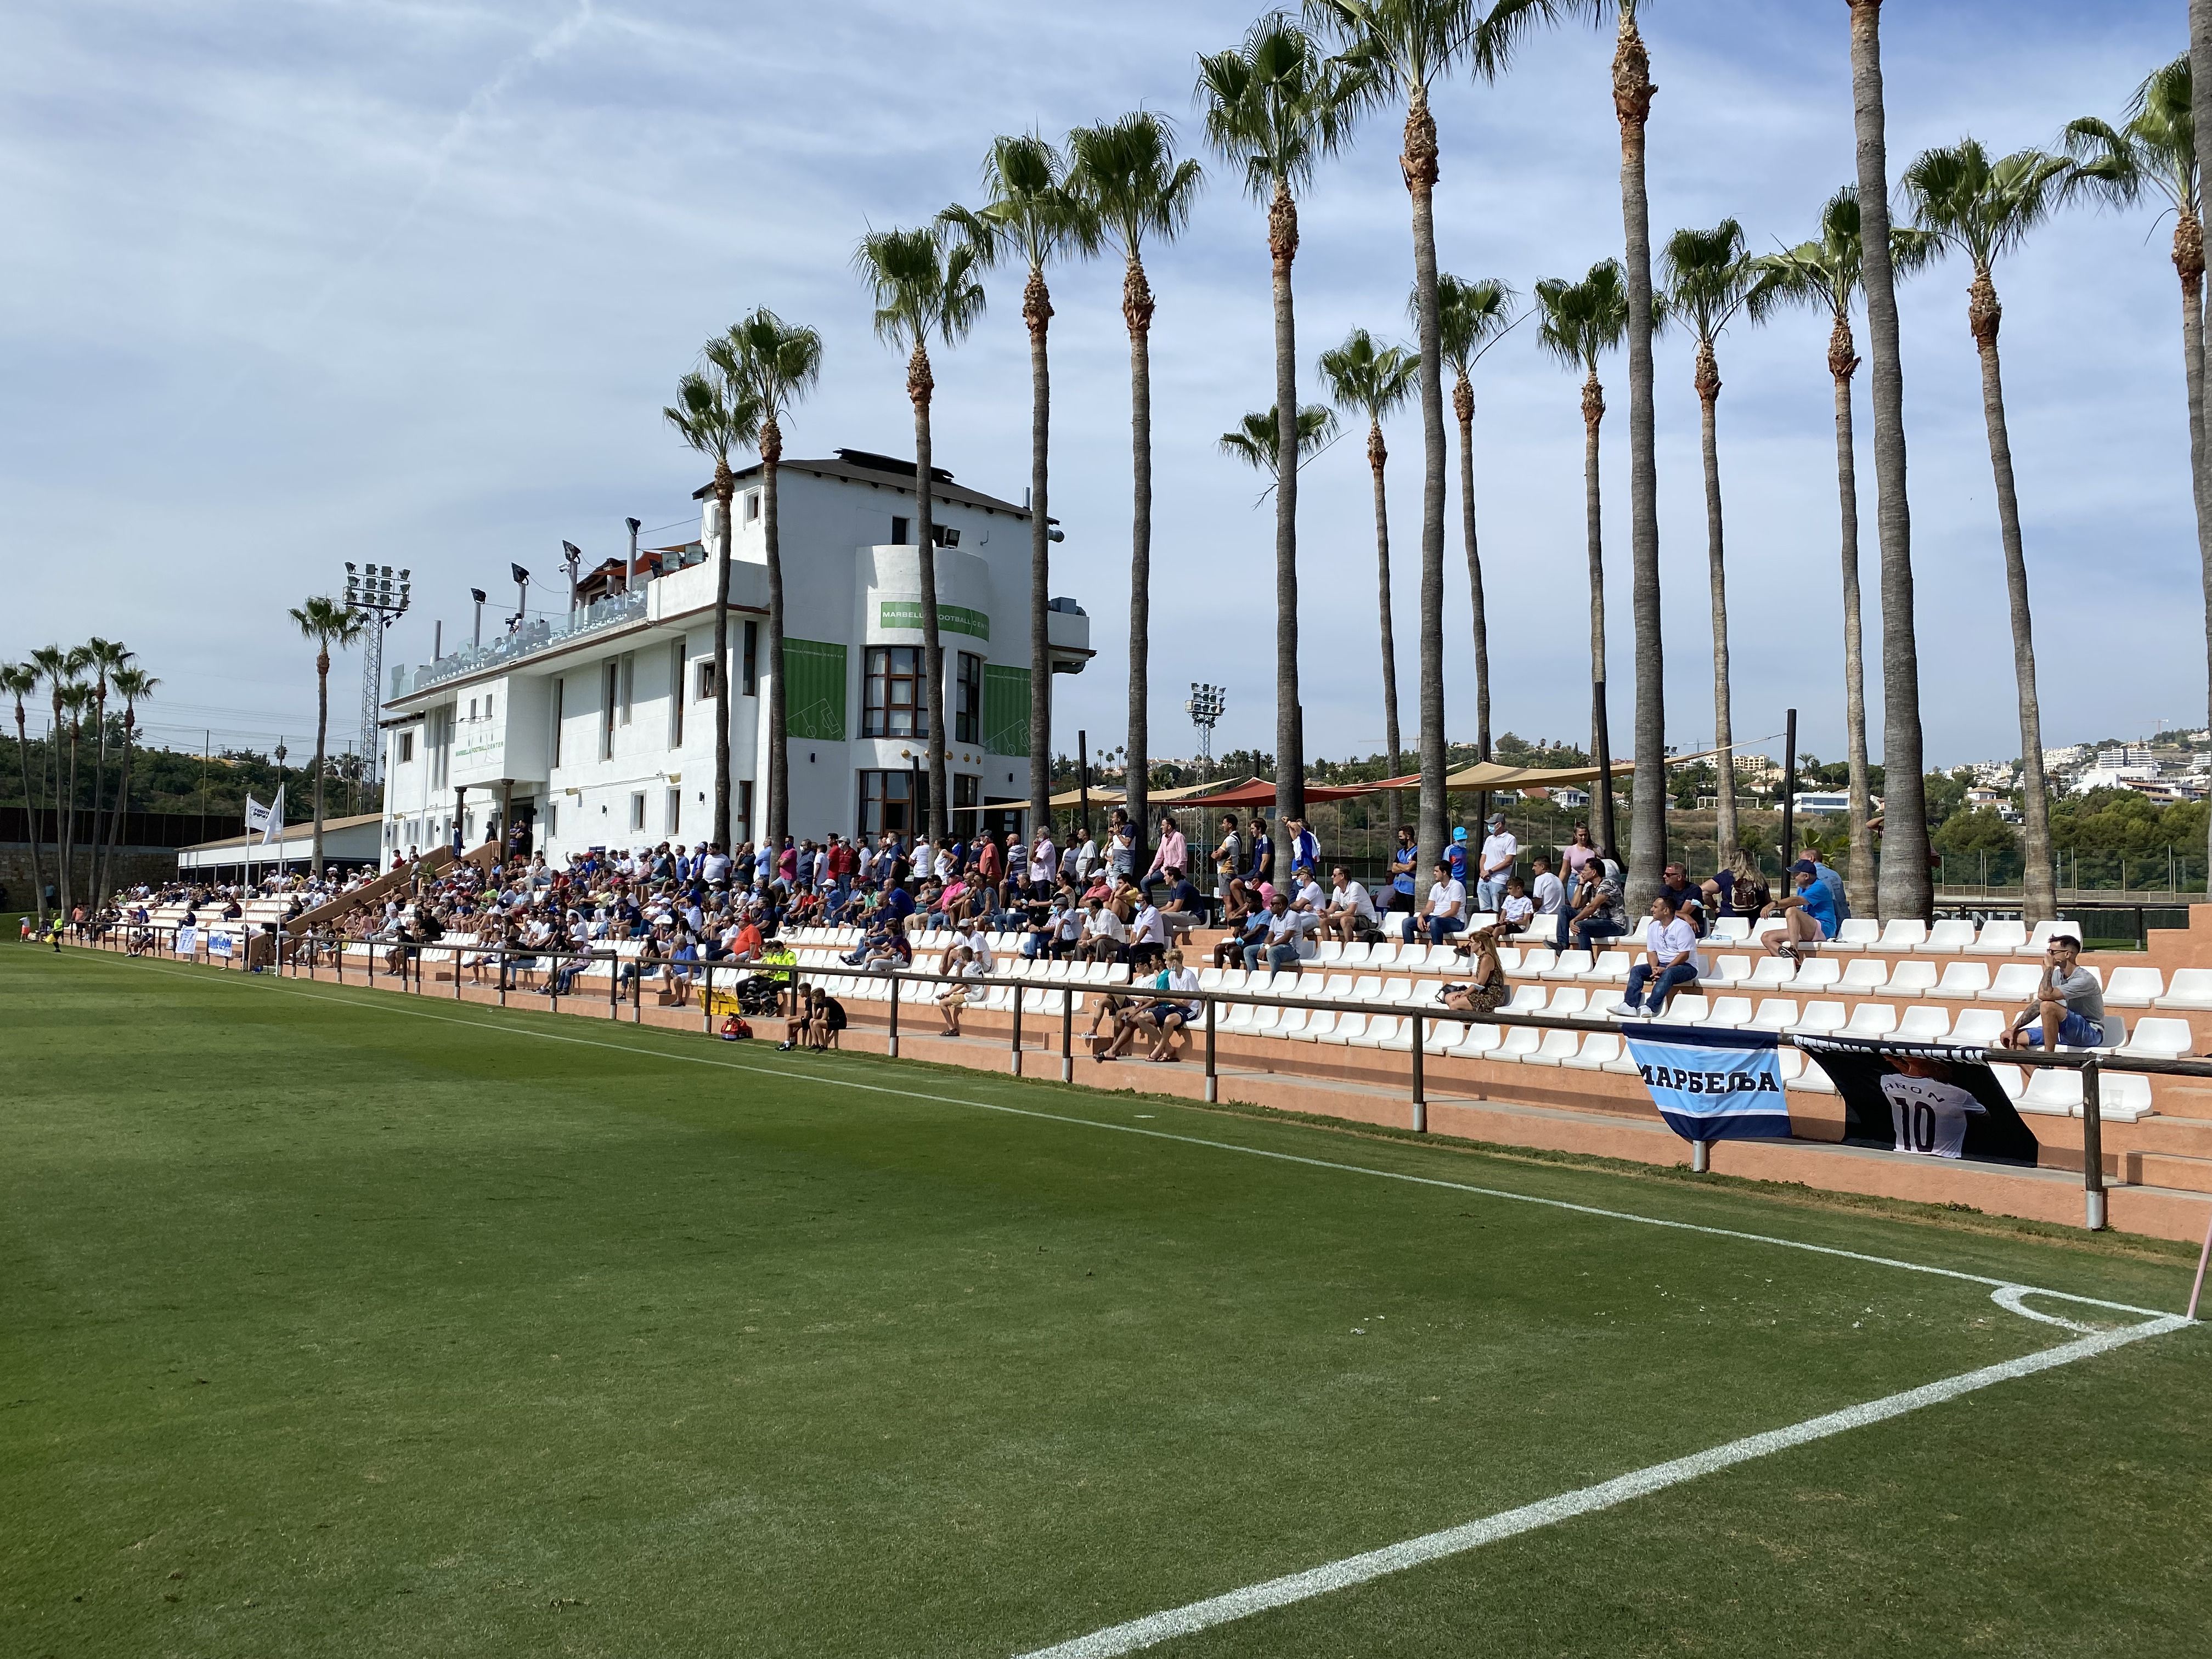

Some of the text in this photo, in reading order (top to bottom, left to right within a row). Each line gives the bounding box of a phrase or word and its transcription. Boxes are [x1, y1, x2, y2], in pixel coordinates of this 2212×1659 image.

[937, 614, 971, 625] OOTBALL
[973, 620, 988, 631] CENT
[472, 745, 487, 753] FOOTBALL
[488, 741, 504, 749] CENTER
[1893, 1097, 1936, 1152] 10
